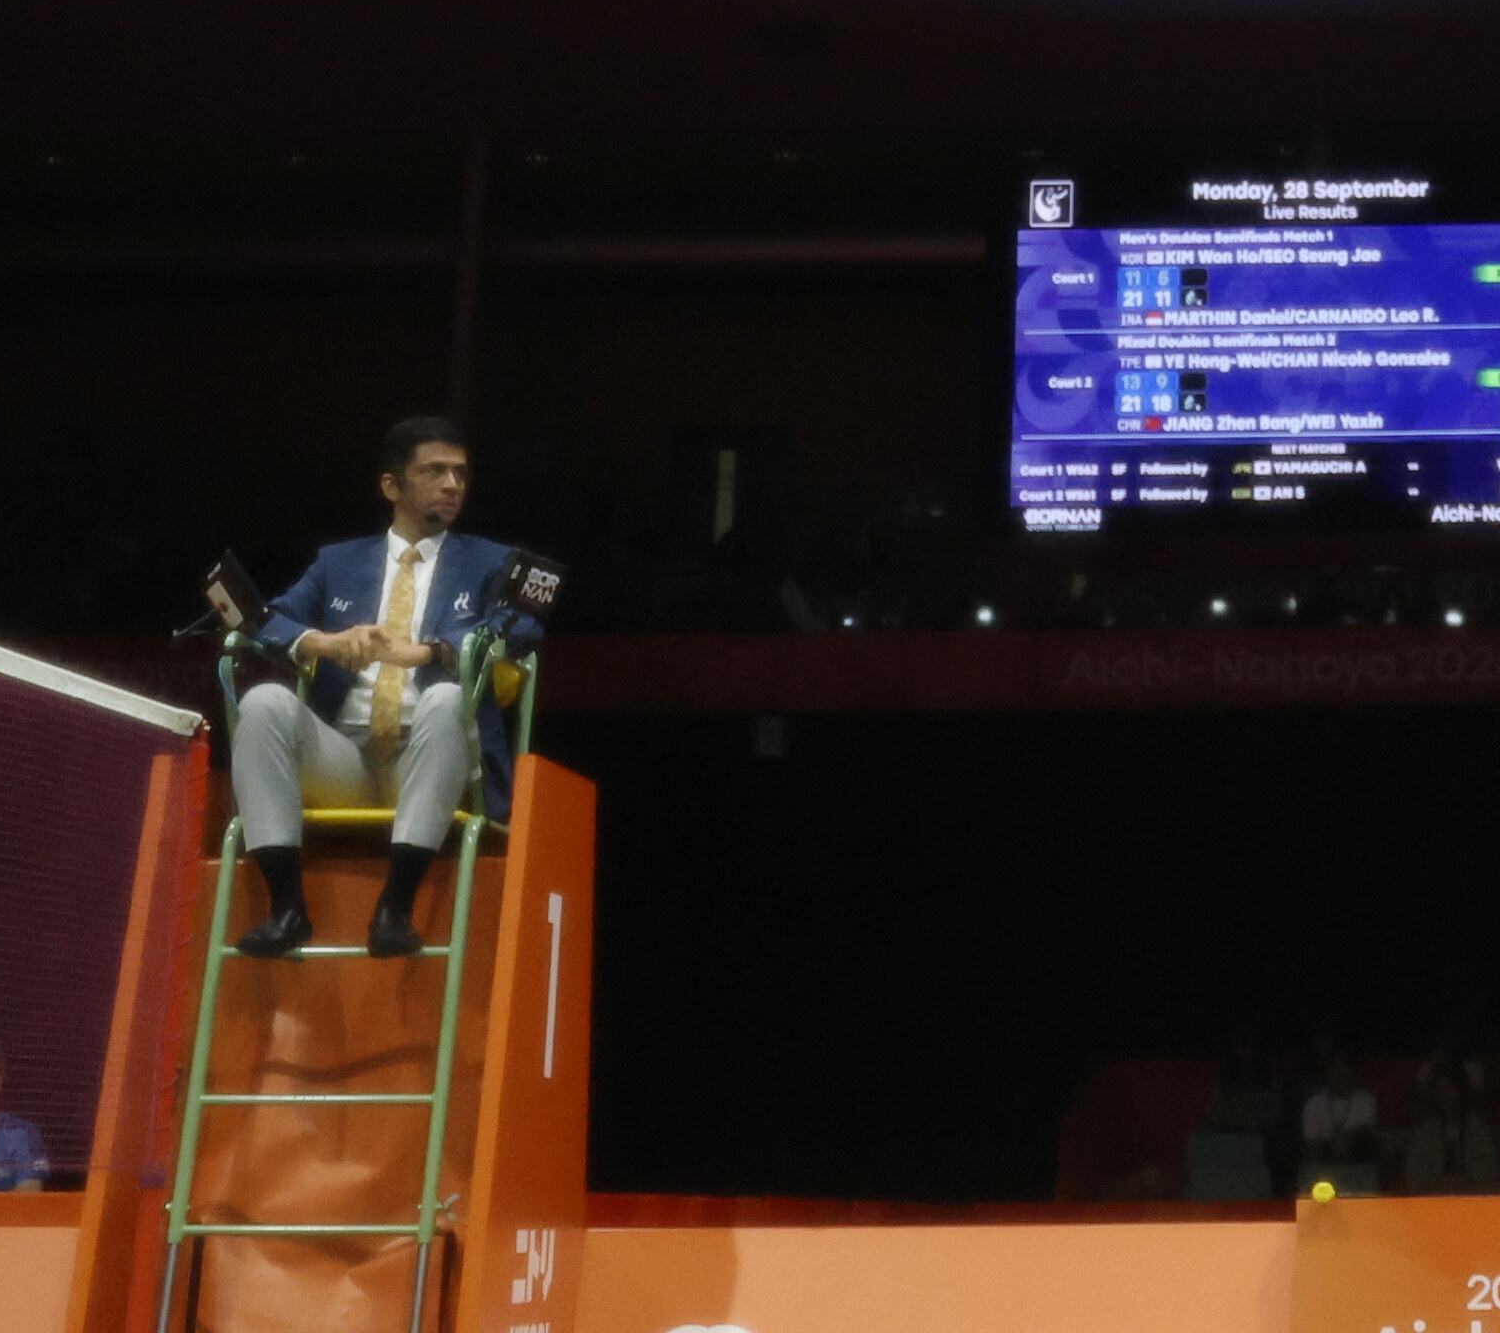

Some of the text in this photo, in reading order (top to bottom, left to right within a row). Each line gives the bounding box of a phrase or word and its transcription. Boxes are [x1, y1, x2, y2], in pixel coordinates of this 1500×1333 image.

[1192, 179, 1430, 203] Monday, 28 September
[1263, 204, 1358, 220] Live Results
[1160, 232, 1211, 244] Doubles
[1165, 250, 1194, 264] KIM
[1198, 250, 1233, 264] Won
[1299, 248, 1349, 266] Seung
[1351, 247, 1382, 263] Jae
[1125, 270, 1142, 285] 11
[1122, 290, 1171, 307] 21 11
[1164, 311, 1236, 325] MARTHIN
[1390, 308, 1419, 323] Leo
[1158, 336, 1210, 348] Doubles
[1165, 354, 1185, 368] YE
[1322, 351, 1373, 366] Nicole
[1121, 373, 1141, 389] 13
[1120, 395, 1142, 412] 21
[1162, 416, 1213, 431] JIANG
[1217, 415, 1256, 431] Zhen
[1340, 412, 1383, 429] Yaxin
[1273, 486, 1294, 500] AN
